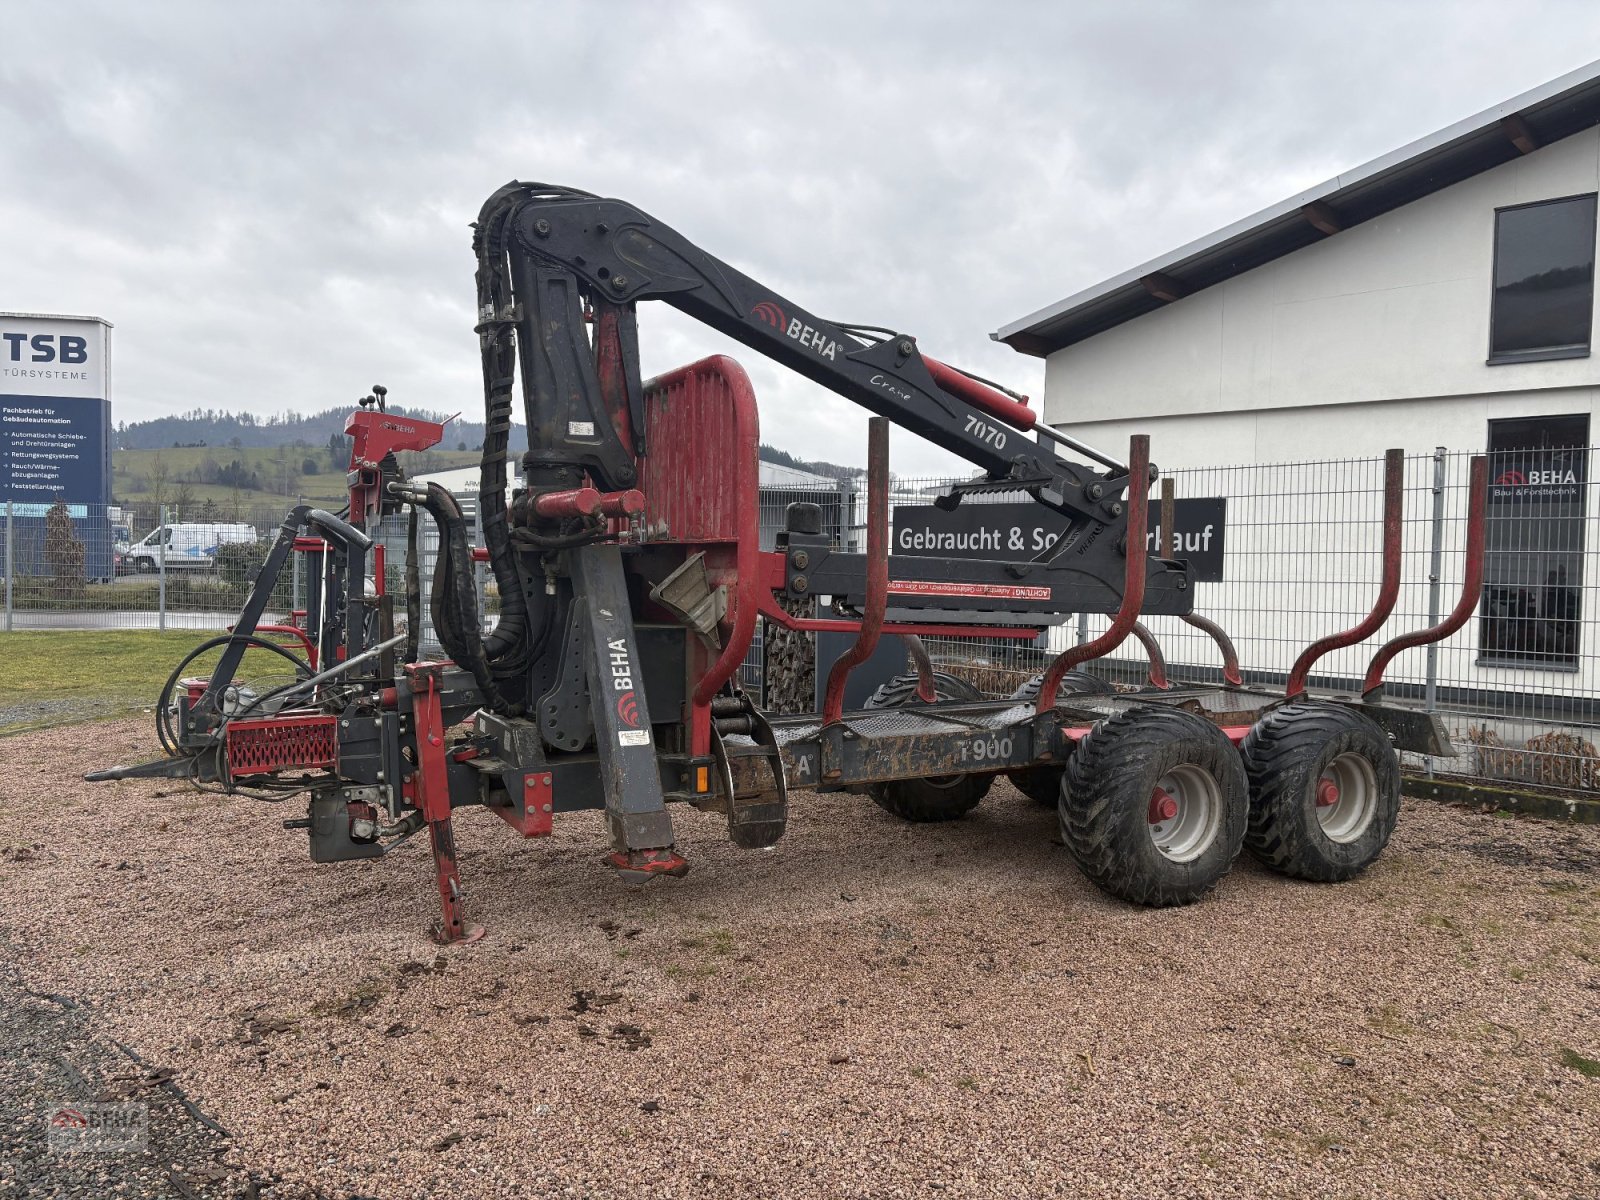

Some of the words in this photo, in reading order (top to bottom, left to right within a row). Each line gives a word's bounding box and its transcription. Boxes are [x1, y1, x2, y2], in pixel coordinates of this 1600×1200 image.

[3, 333, 87, 364] TSB
[3, 368, 88, 380] TÜRSYSTEME
[870, 374, 911, 400] Crane
[2, 407, 43, 415] Fachbetrieb
[2, 416, 71, 424] Gebäudeautomation
[11, 431, 56, 439] Automatische
[964, 414, 1007, 450] 7070
[25, 441, 76, 449] Drehtüranlagen
[11, 451, 79, 460] Rettungswegsysteme
[11, 471, 59, 479] abzugsanlagen
[1528, 470, 1577, 485] BEHA
[11, 482, 65, 491] Feststellanlagen
[900, 527, 1001, 550] Gebraucht
[1007, 526, 1025, 551] &
